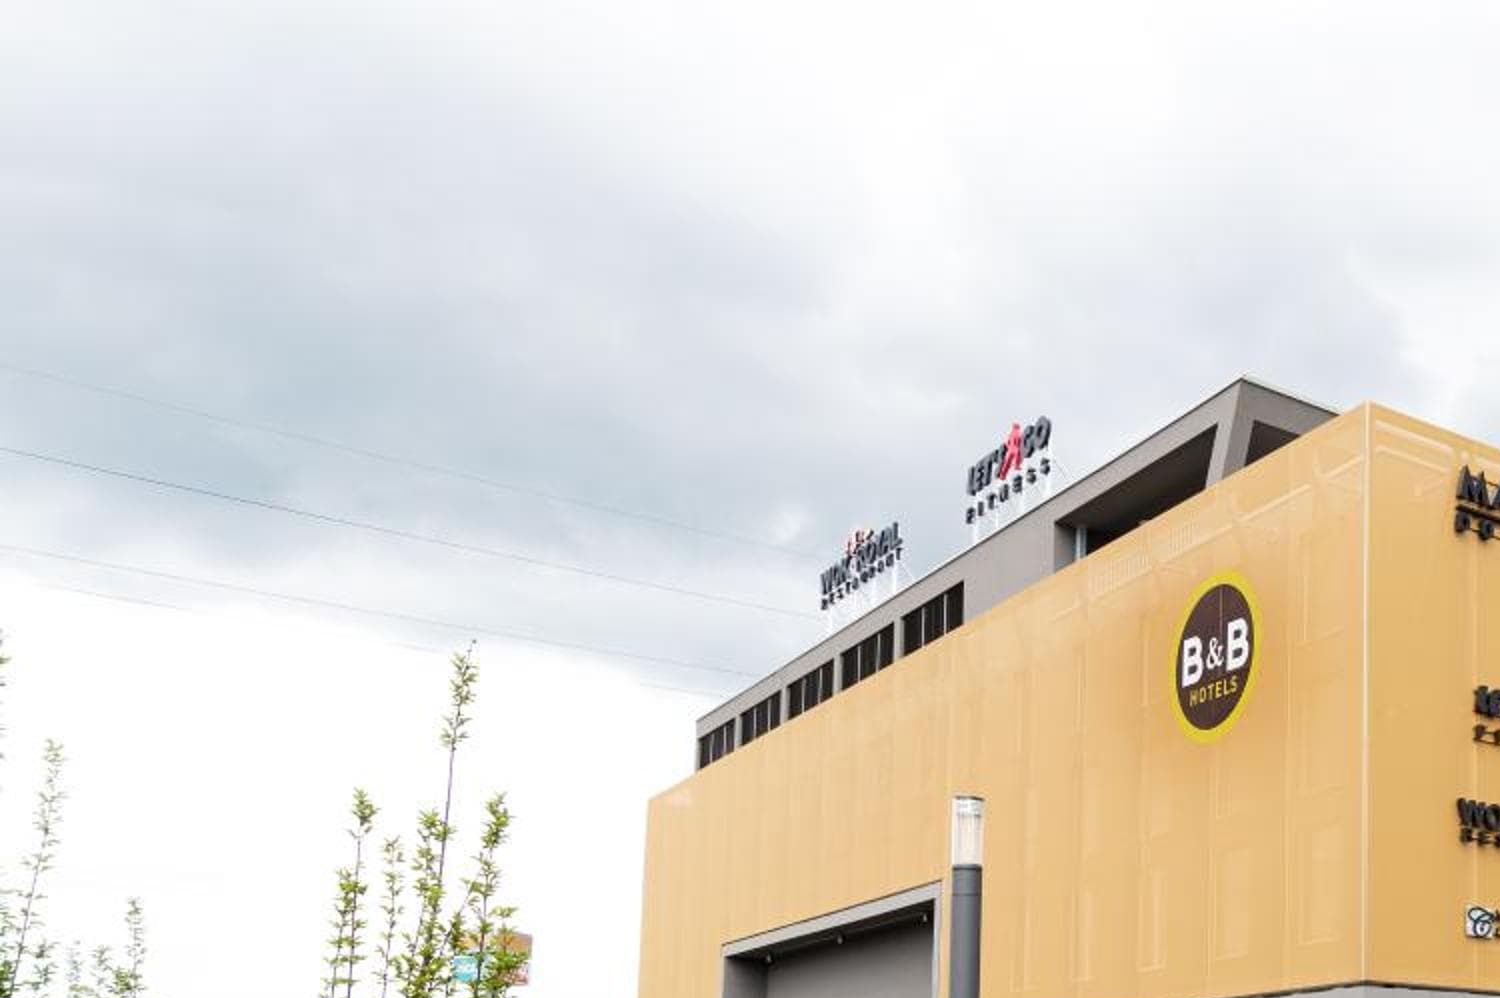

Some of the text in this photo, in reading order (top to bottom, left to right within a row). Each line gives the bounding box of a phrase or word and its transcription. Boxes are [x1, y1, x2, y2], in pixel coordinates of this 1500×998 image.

[966, 457, 1051, 524] FITNESS
[820, 547, 903, 610] RESTAURANT
[1182, 617, 1249, 688] B&B
[1189, 675, 1238, 707] HOTELS
